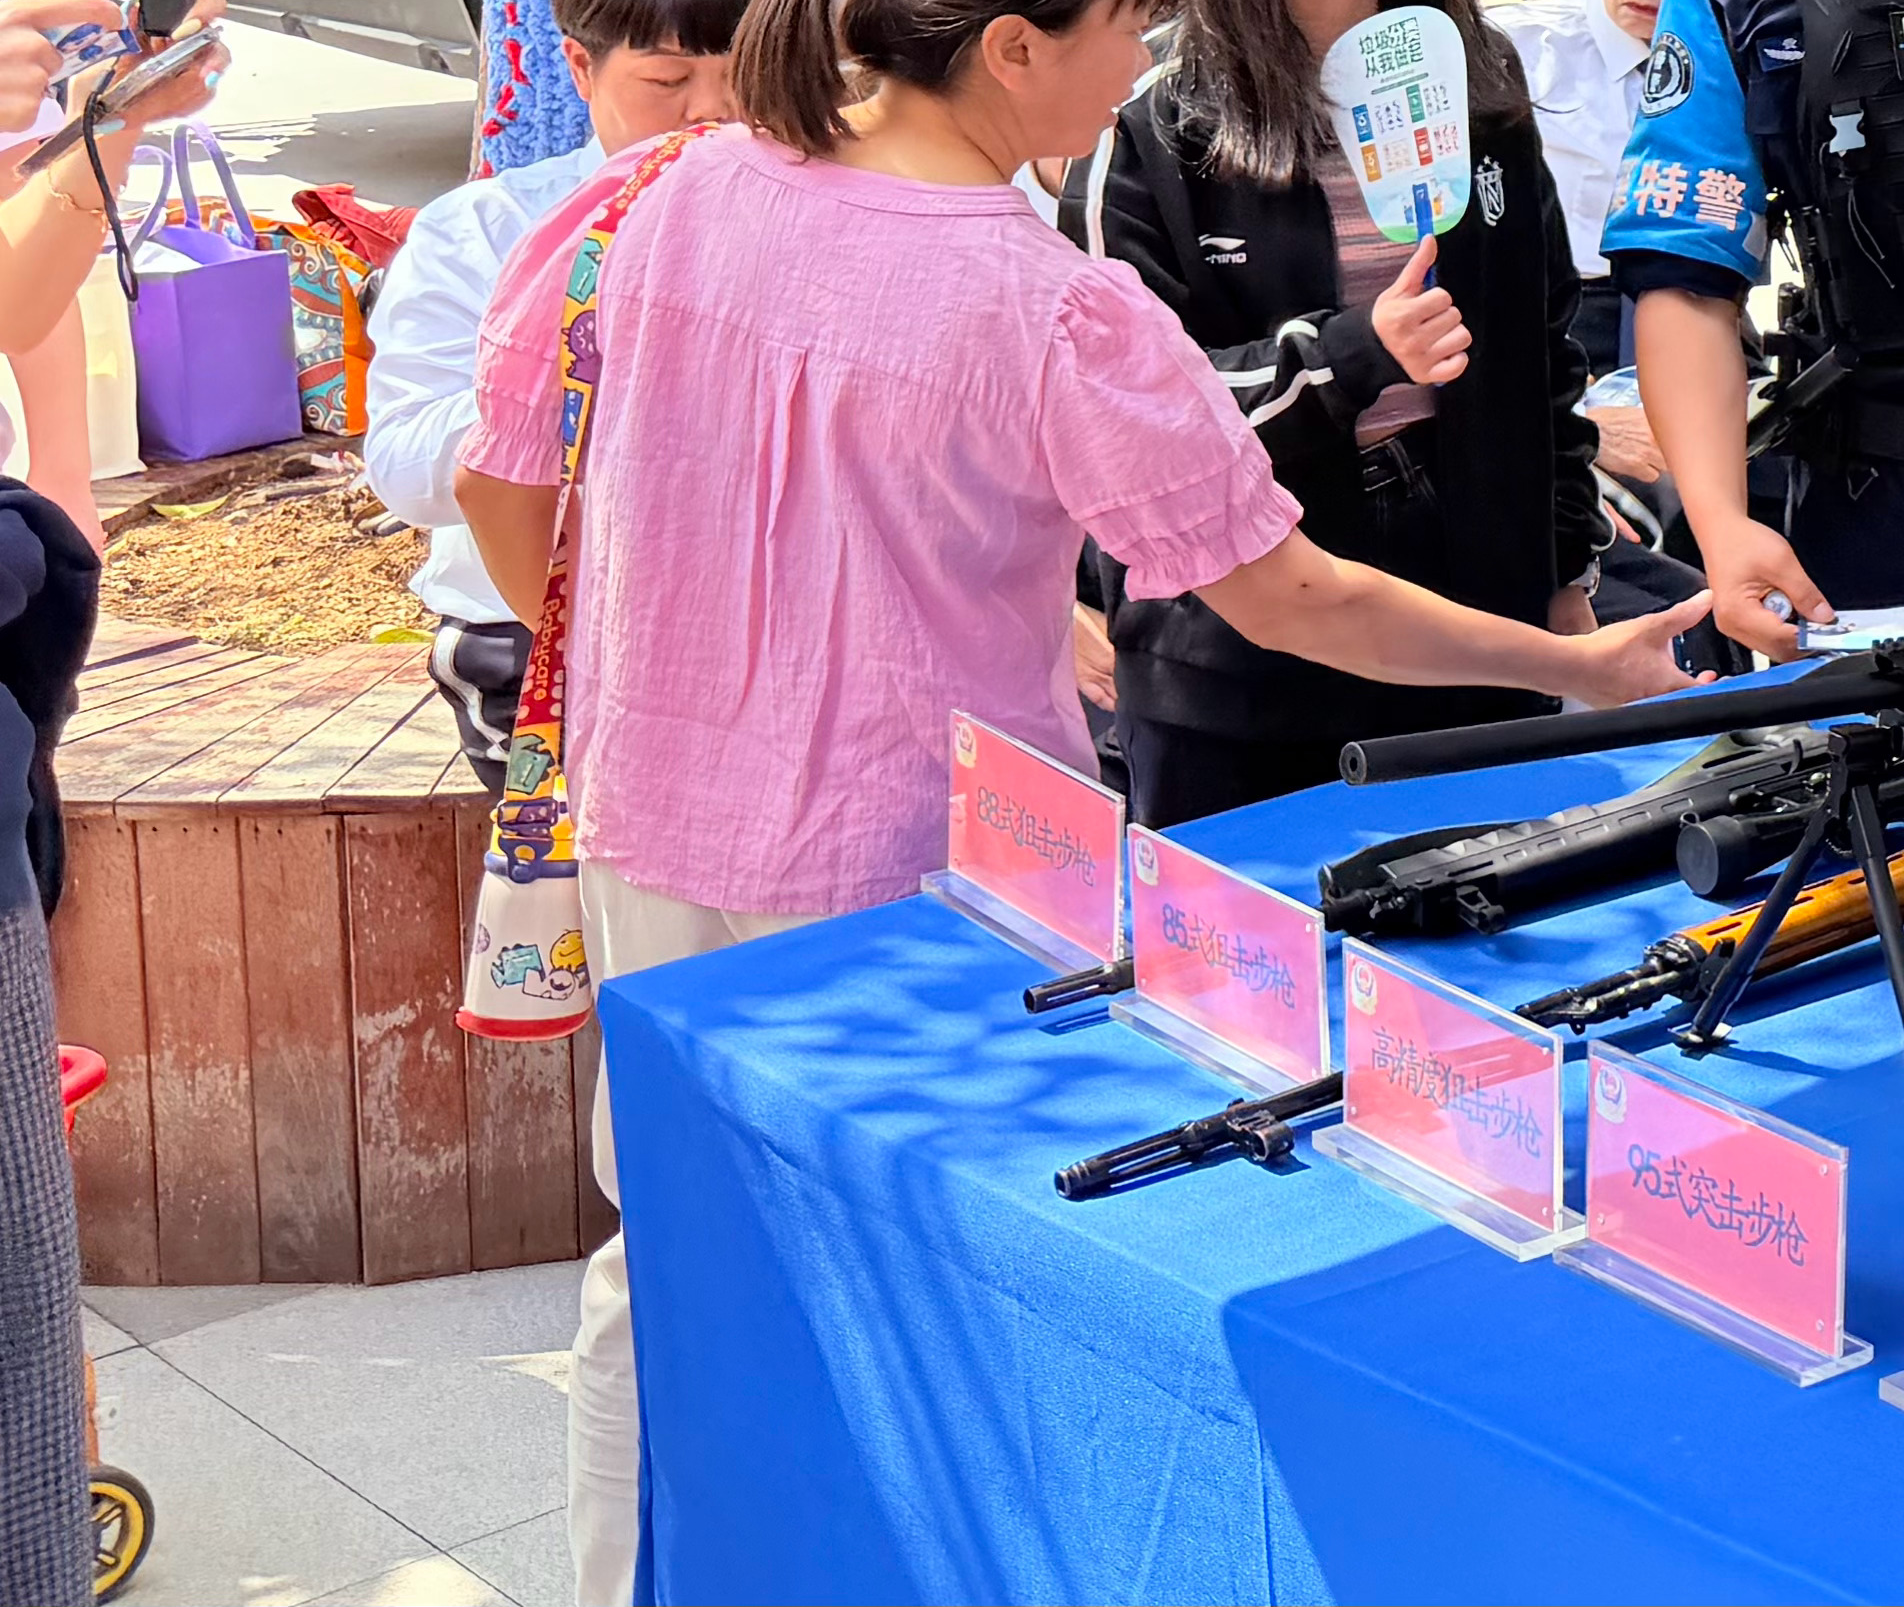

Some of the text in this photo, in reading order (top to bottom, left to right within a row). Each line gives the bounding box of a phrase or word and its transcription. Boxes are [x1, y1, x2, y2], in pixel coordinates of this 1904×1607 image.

[615, 131, 699, 210] Babycare
[532, 597, 561, 702] Babycare
[977, 785, 1097, 887] 88式狙击步枪
[1161, 902, 1296, 1009] 85式狙击步枪
[1371, 1025, 1544, 1159] 高精度狙击步枪
[1627, 1143, 1809, 1267] 95式突击步枪
